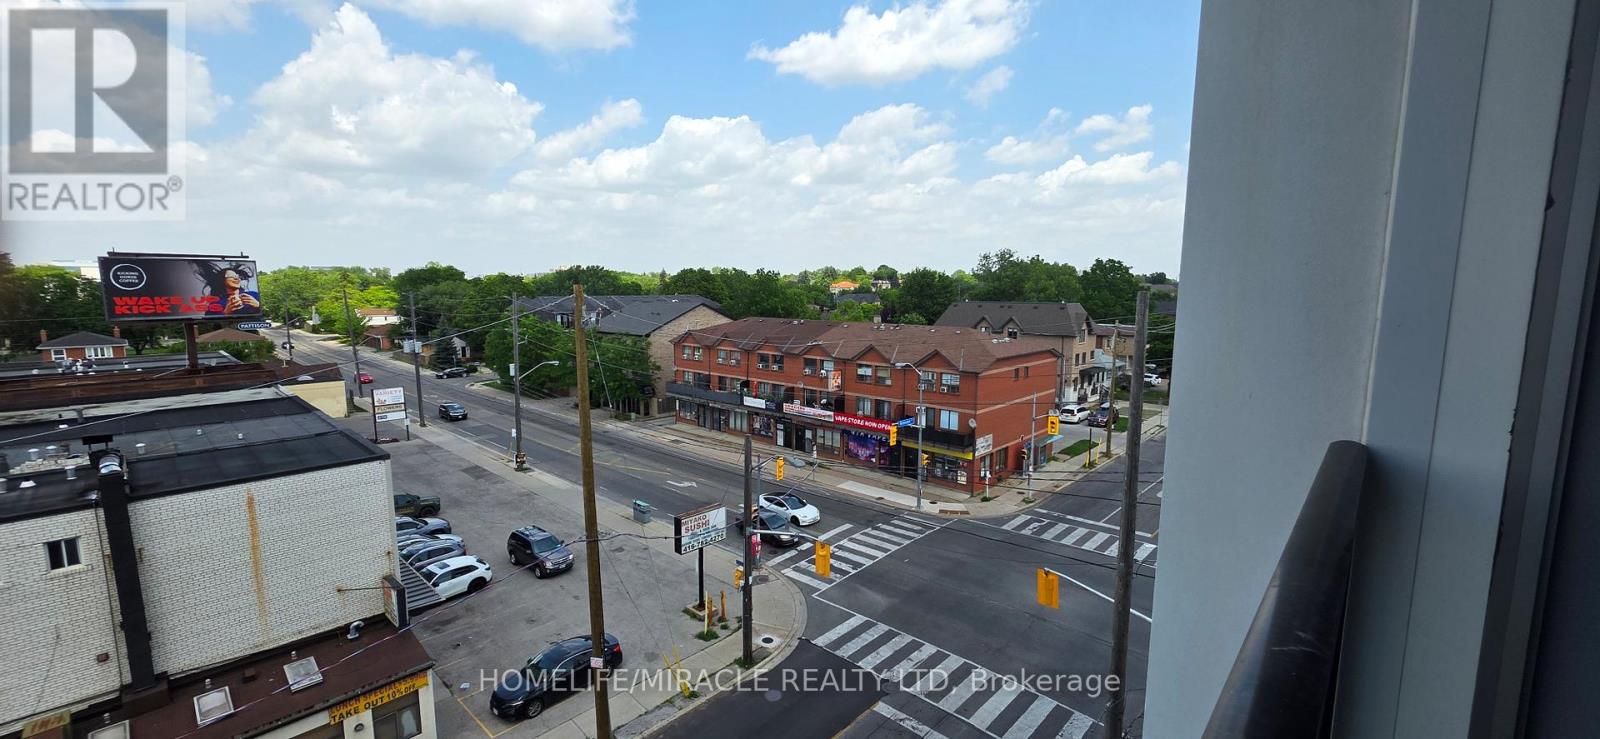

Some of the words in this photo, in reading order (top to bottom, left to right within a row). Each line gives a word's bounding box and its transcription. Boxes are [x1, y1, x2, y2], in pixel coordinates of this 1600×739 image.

[113, 296, 183, 306] WAKE
[190, 296, 221, 304] UP
[114, 304, 172, 314] KICK
[682, 514, 706, 526] MIYAKO
[684, 520, 710, 534] SUSHI
[332, 706, 360, 721] TAKE
[364, 697, 385, 710] OUT
[387, 690, 403, 700] 10%
[404, 684, 416, 694] OFF
